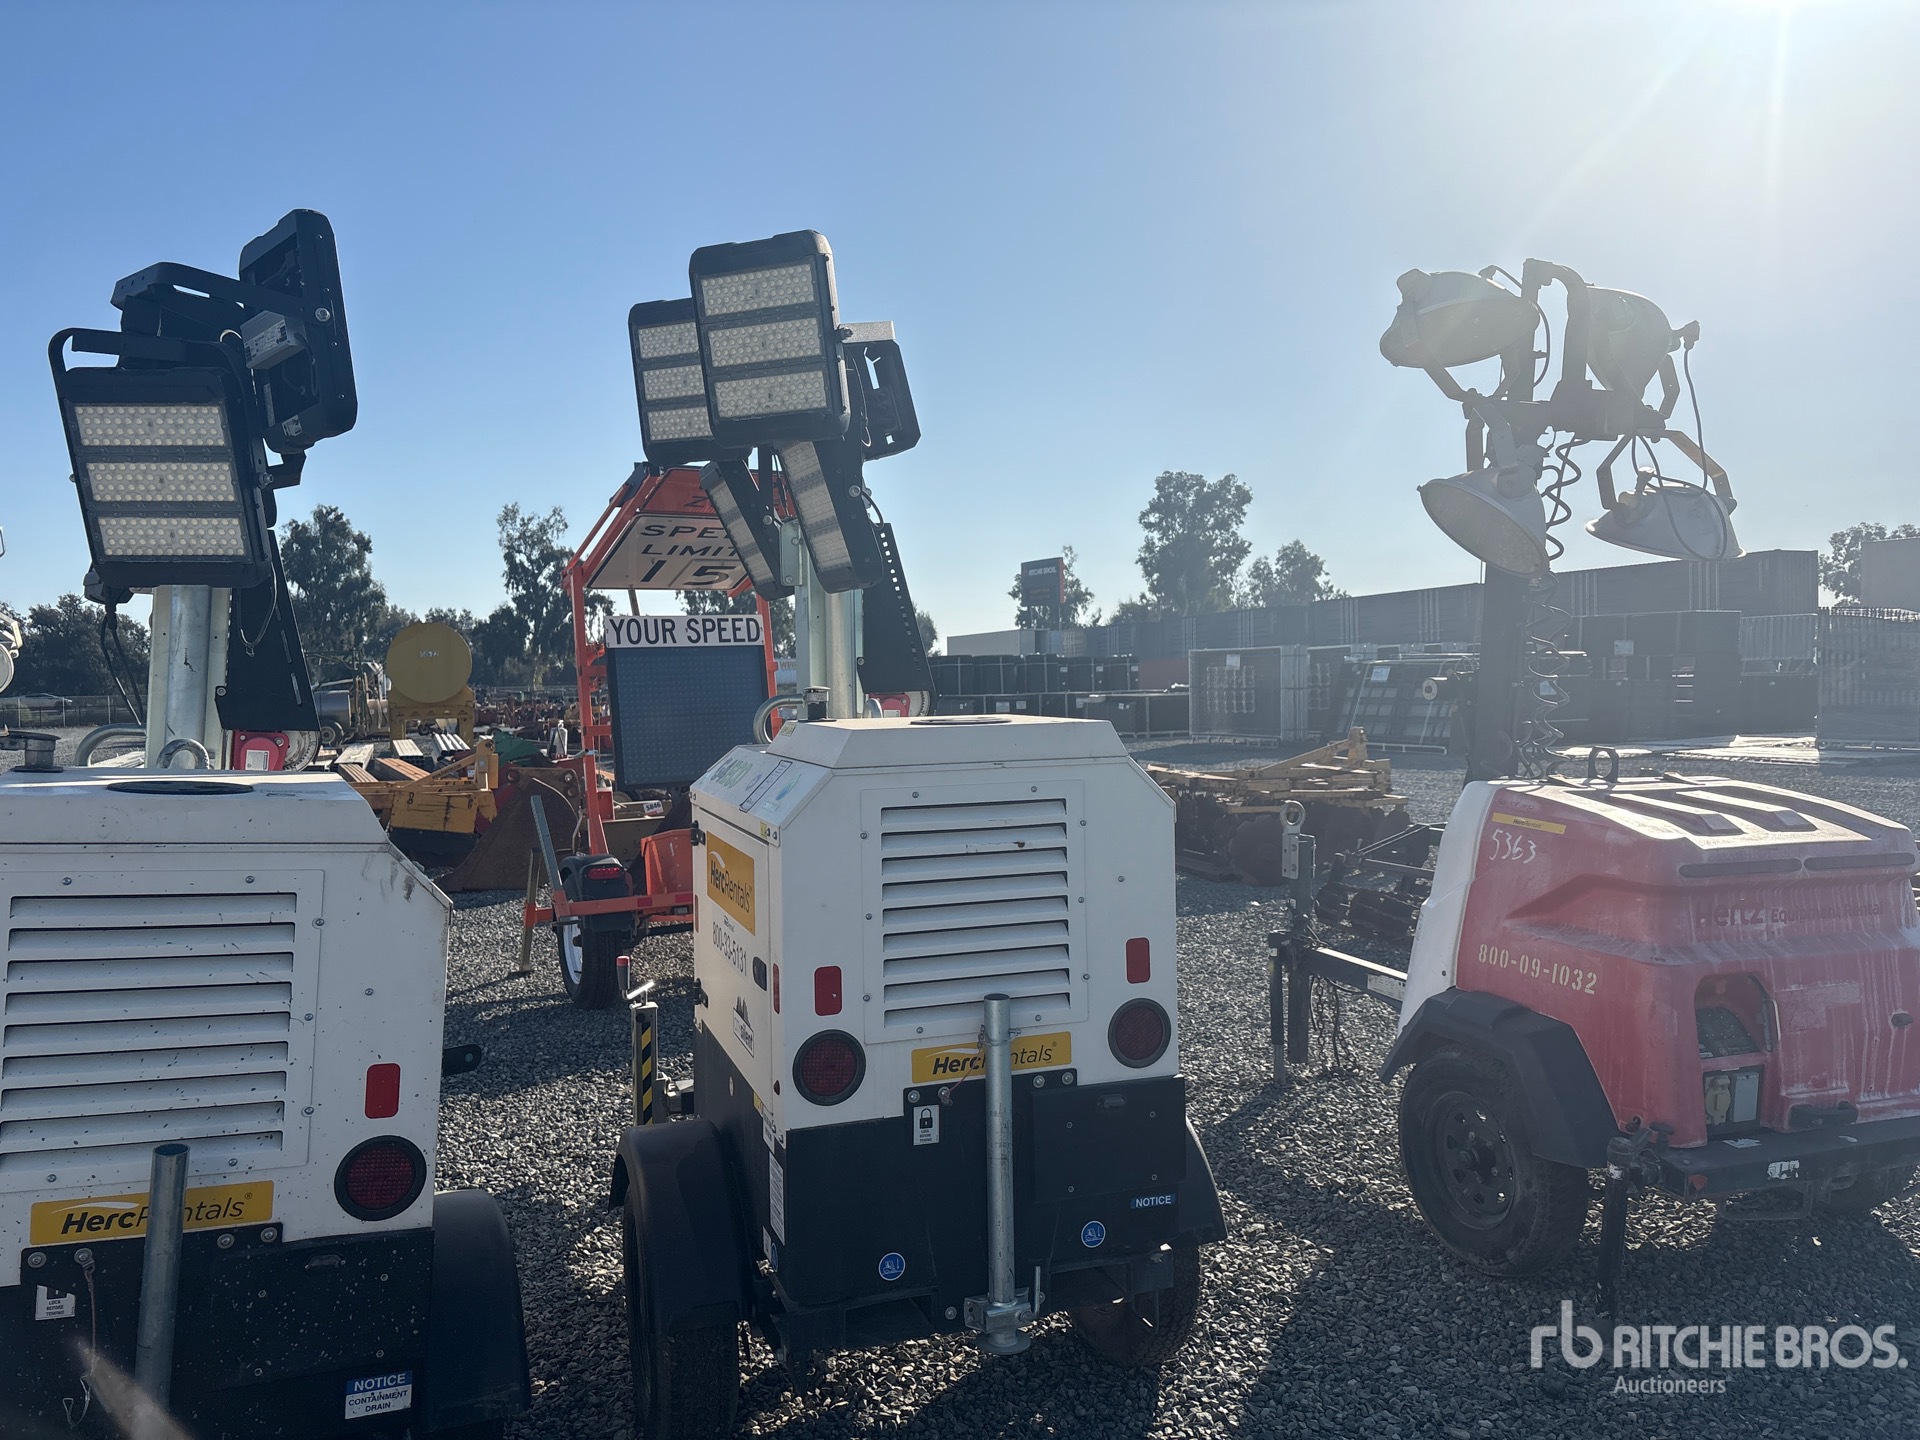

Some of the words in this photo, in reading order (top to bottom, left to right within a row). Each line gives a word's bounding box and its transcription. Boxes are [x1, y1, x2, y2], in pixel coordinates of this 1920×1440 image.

[640, 524, 728, 539] SPE
[641, 560, 738, 586] 15
[609, 617, 677, 645] YOUR
[686, 616, 761, 644] SPEED
[1488, 828, 1537, 864] 5363
[710, 859, 750, 913] HercRentals
[1478, 943, 1597, 995] 800-09-1032
[1134, 1195, 1172, 1208] NOTICE
[354, 1373, 406, 1392] NOTICE
[348, 1389, 408, 1407] CONTAINMENT
[365, 1401, 391, 1413] DRAIN
